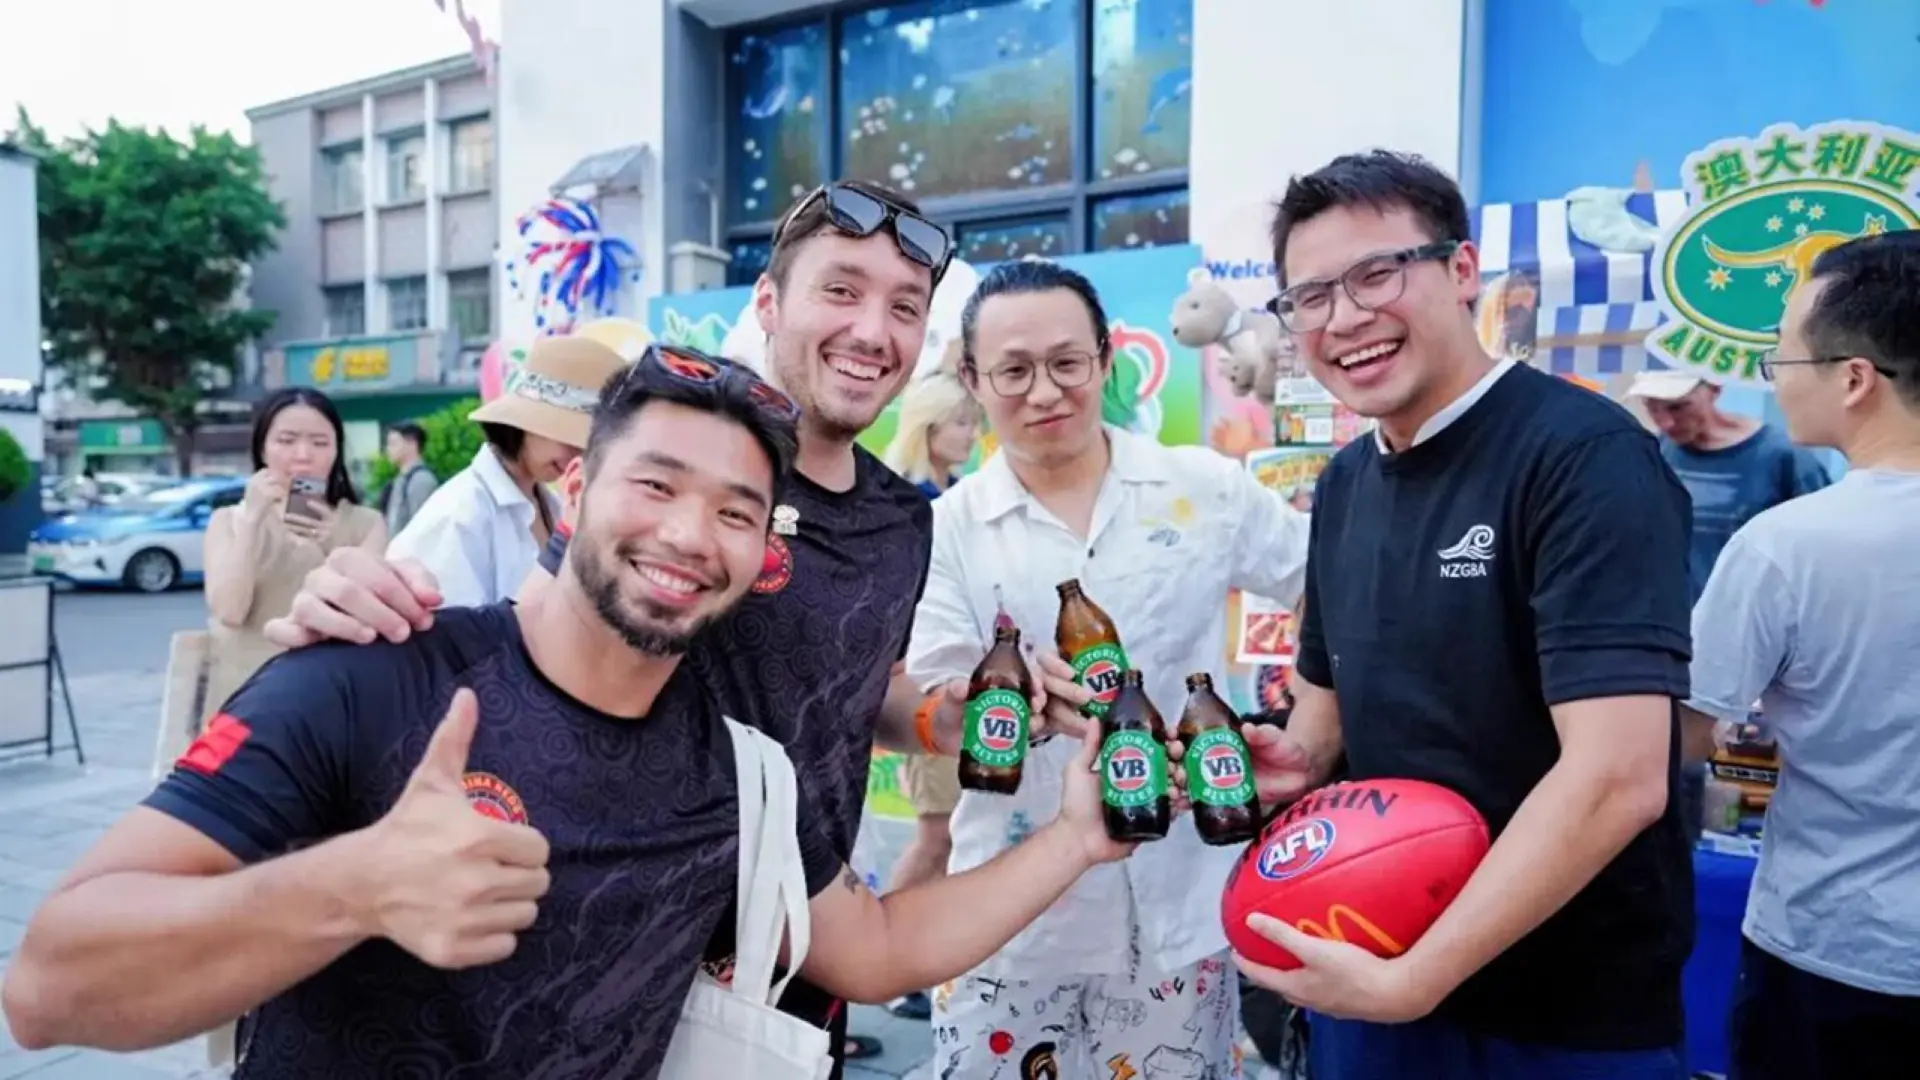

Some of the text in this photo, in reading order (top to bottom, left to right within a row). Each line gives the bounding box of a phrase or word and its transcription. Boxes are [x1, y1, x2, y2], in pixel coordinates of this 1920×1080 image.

[1695, 132, 1920, 198] 澳大利亚
[1206, 258, 1276, 279] Welco
[1660, 325, 1761, 379] AUST
[1440, 561, 1487, 578] NZGBA
[1074, 648, 1120, 673] ICTORIA
[1086, 669, 1119, 693] VB
[974, 695, 1026, 719] VICTORIA
[983, 718, 1016, 740] VB
[1103, 734, 1154, 758] VICTORIA
[1111, 759, 1147, 779] VB
[1205, 756, 1241, 777] VB
[1266, 826, 1328, 874] AFL
